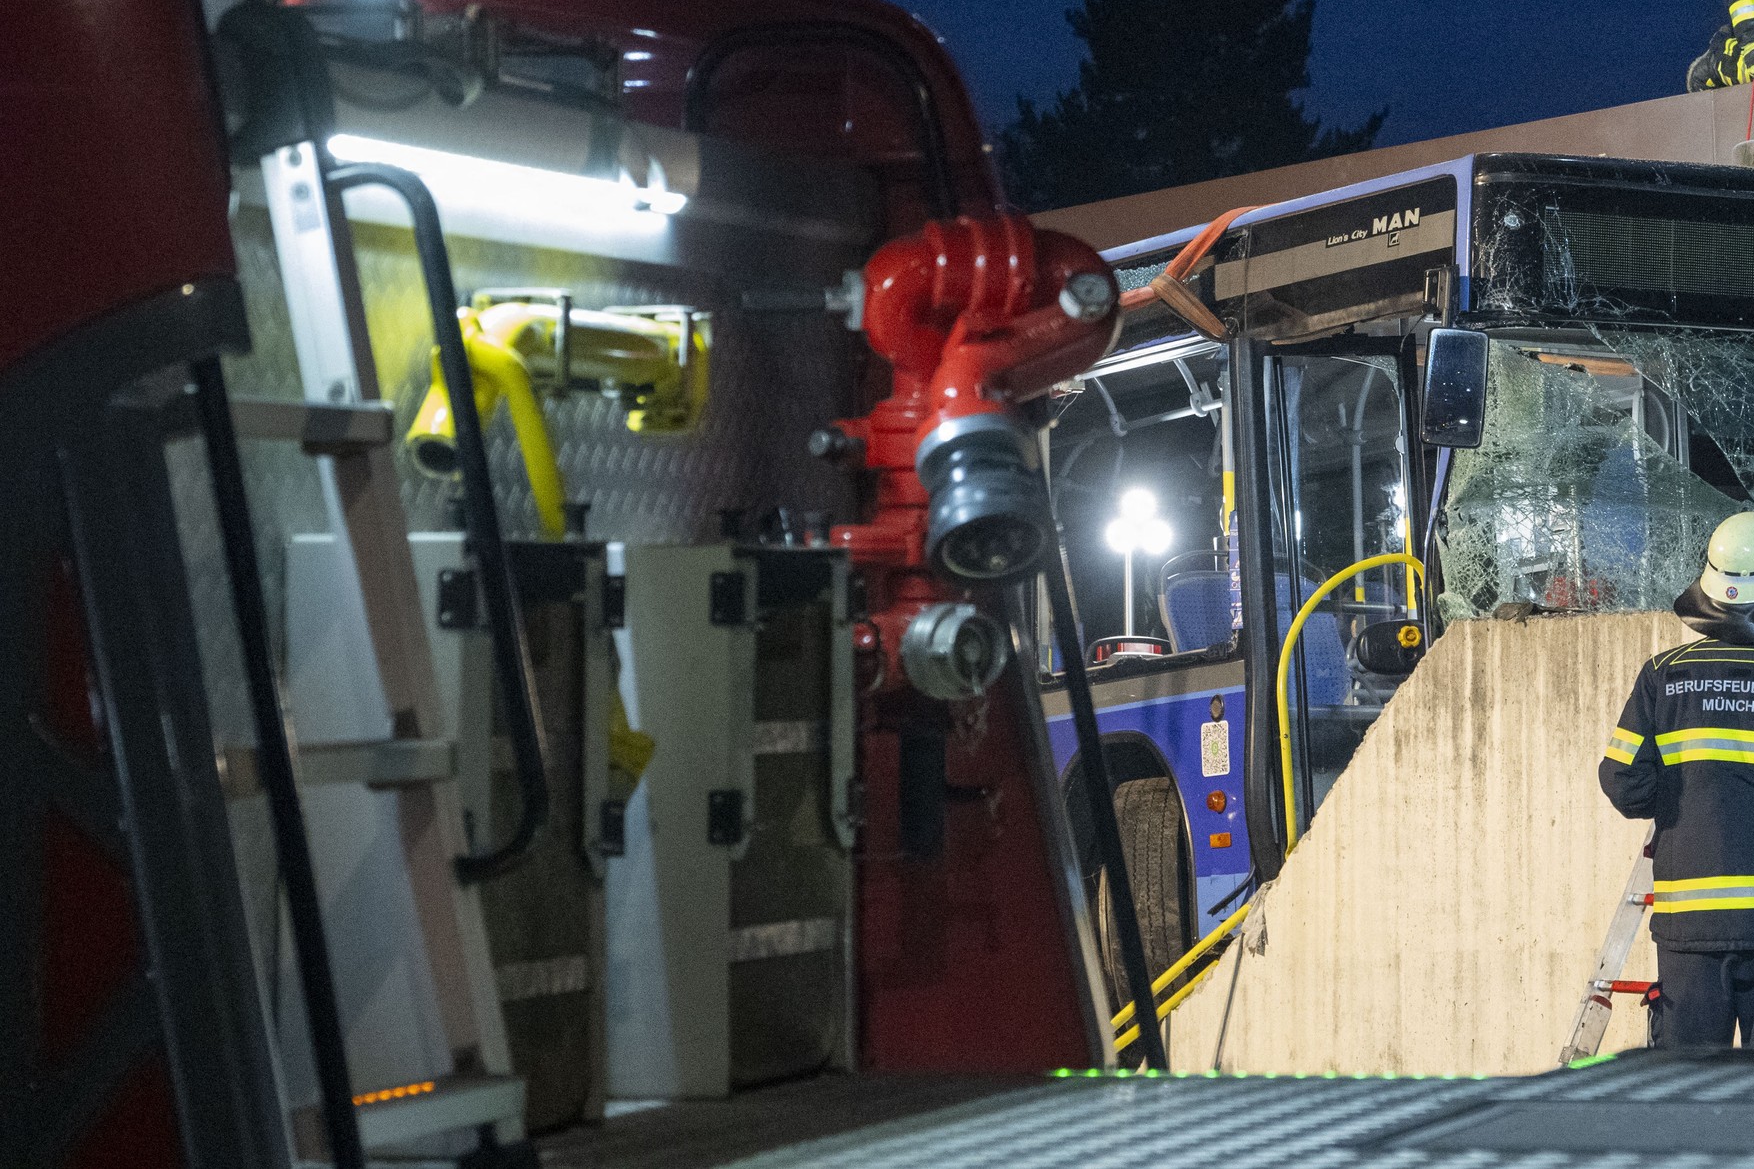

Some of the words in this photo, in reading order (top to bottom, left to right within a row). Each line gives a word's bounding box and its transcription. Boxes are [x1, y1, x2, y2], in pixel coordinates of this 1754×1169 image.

[1327, 233, 1349, 246] Lion's
[1351, 230, 1368, 240] City
[1372, 207, 1420, 235] MAN
